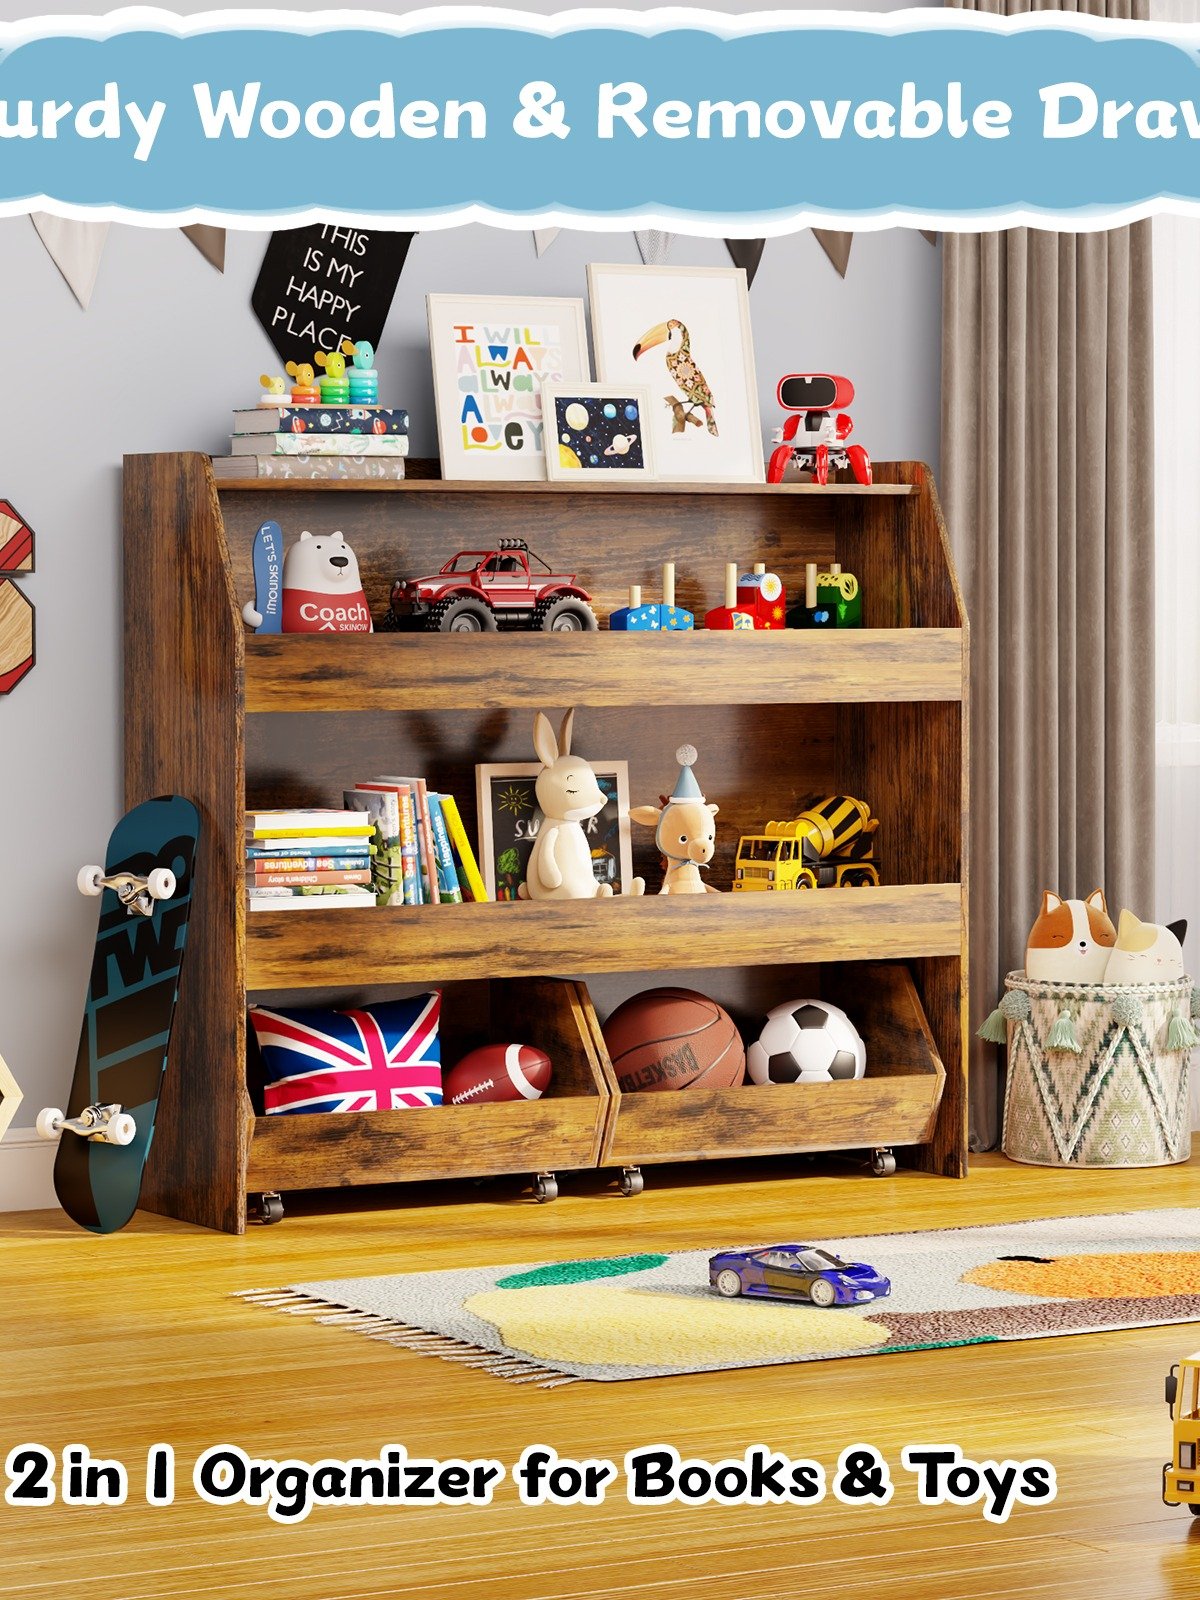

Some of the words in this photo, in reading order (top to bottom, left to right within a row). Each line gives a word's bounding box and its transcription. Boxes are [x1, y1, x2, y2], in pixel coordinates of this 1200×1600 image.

[321, 224, 370, 256] THIS
[303, 247, 323, 272] IS
[326, 257, 364, 288] MY
[286, 275, 361, 322] HAPPY
[271, 305, 352, 357] PLACE
[453, 325, 475, 343] I
[483, 327, 560, 345] WILL
[457, 345, 561, 373] ALWAYS
[261, 526, 277, 563] LET'S
[299, 602, 368, 622] Coach
[339, 623, 368, 631] SKINOW
[402, 795, 413, 854] adventures
[434, 815, 452, 867] Happiness
[263, 860, 315, 871] adventures
[316, 859, 335, 869] Sea
[405, 855, 414, 878] Sea
[268, 875, 284, 883] story
[285, 875, 318, 883] Children's
